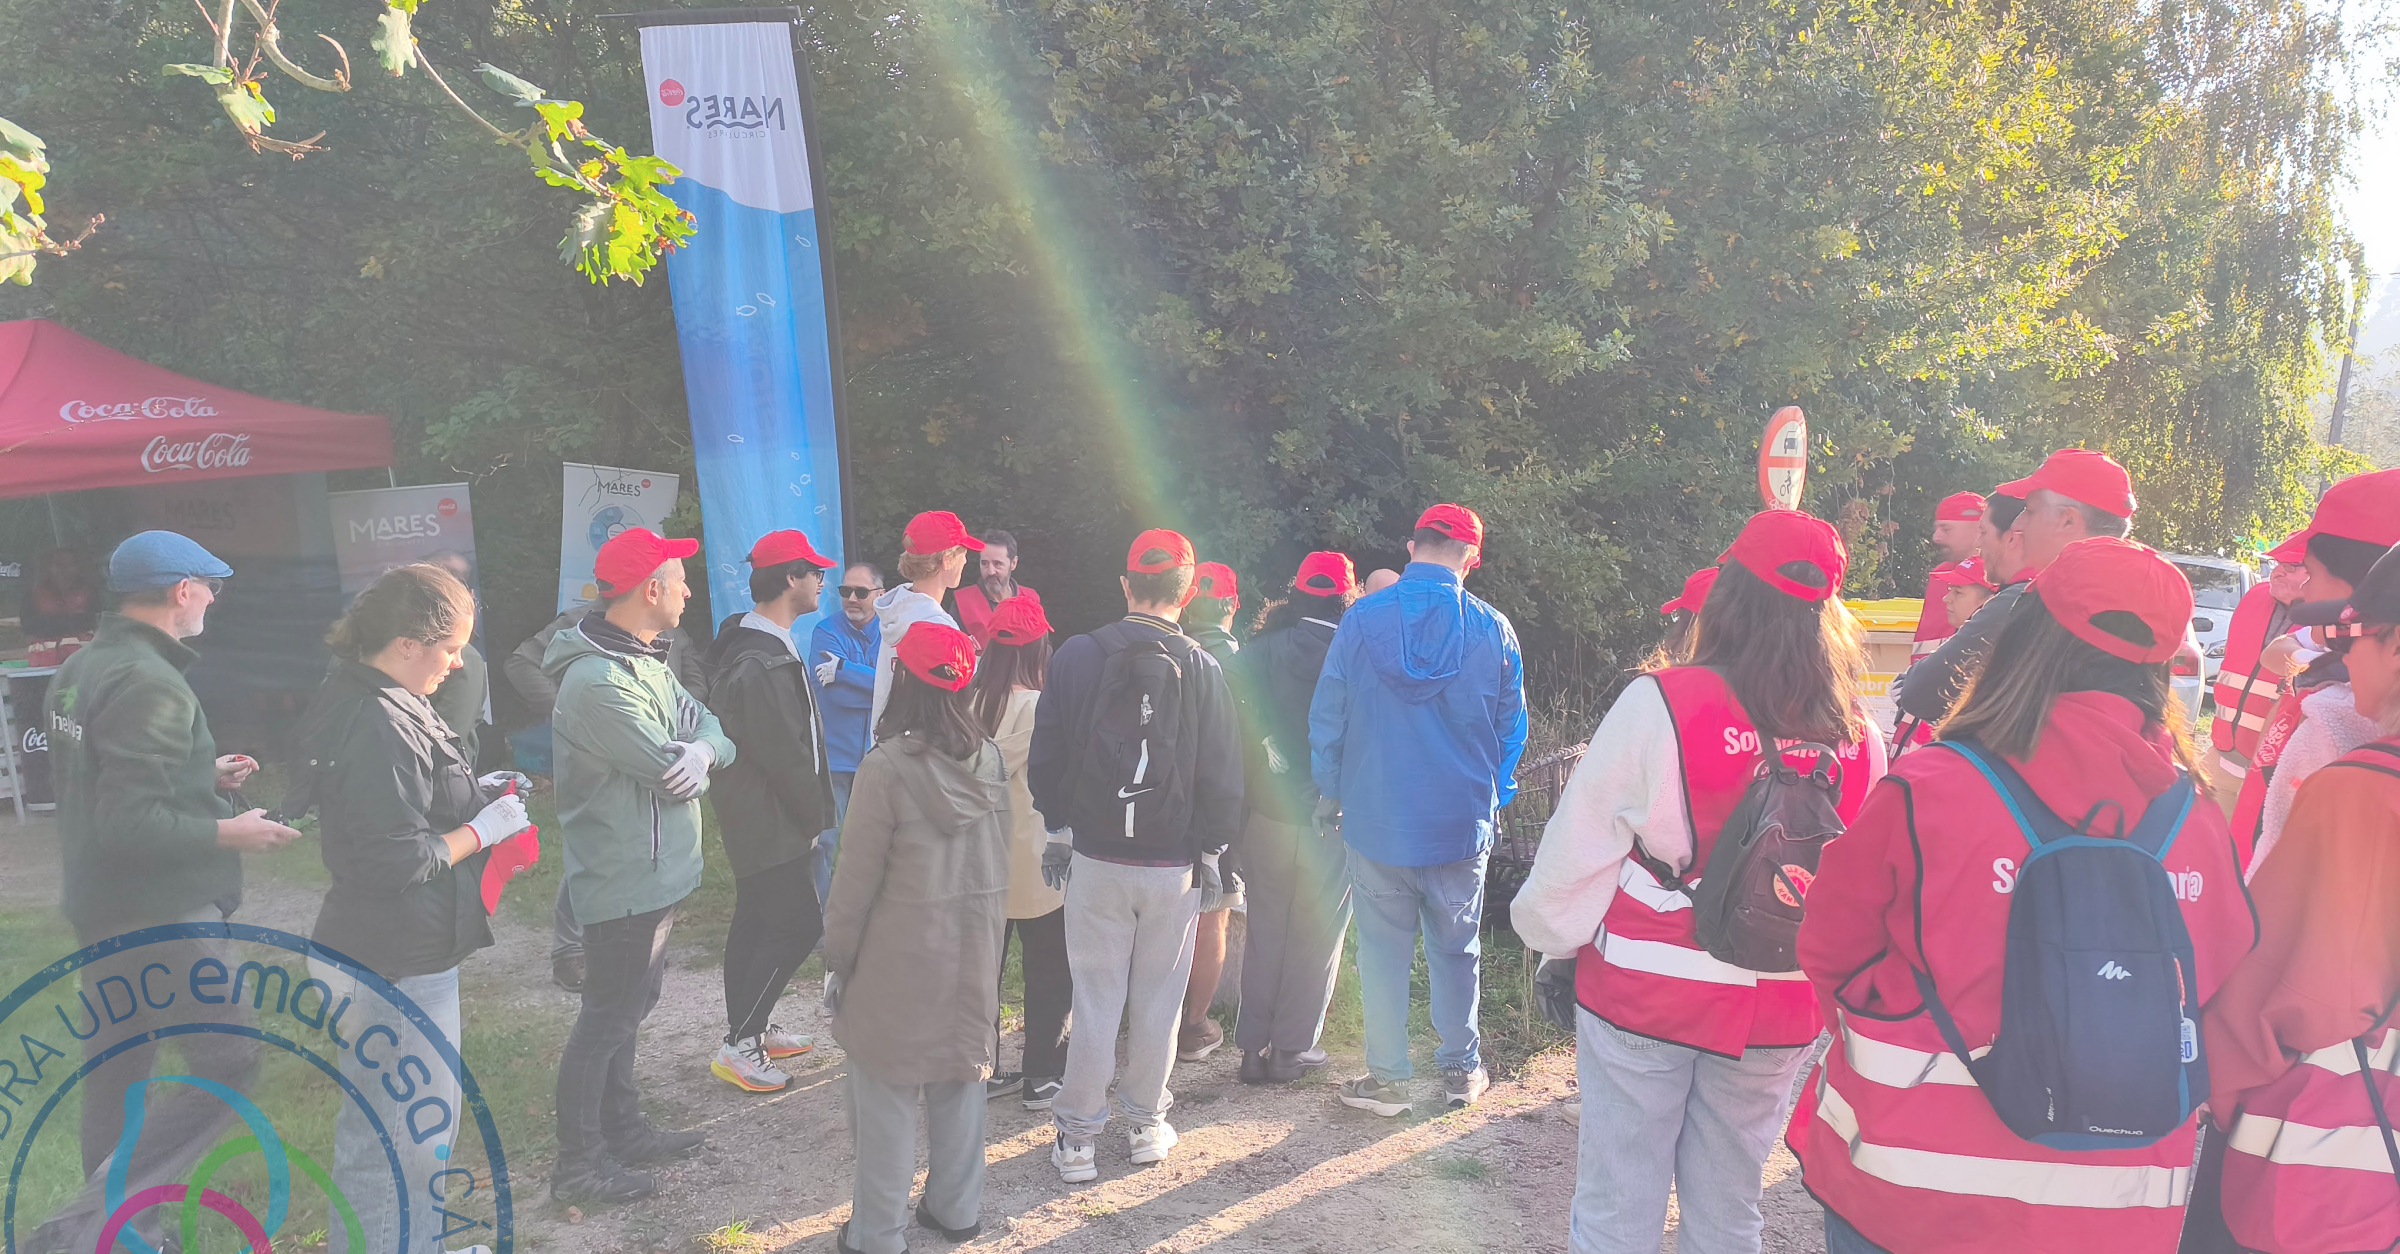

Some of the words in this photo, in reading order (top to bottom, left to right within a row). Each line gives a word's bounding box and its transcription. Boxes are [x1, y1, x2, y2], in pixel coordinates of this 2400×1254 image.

[59, 397, 219, 423] Coca-Cola
[141, 432, 252, 473] Coca-Cola
[597, 481, 641, 497] MARES
[349, 513, 441, 543] MARES
[2089, 1125, 2143, 1136] Quechua
